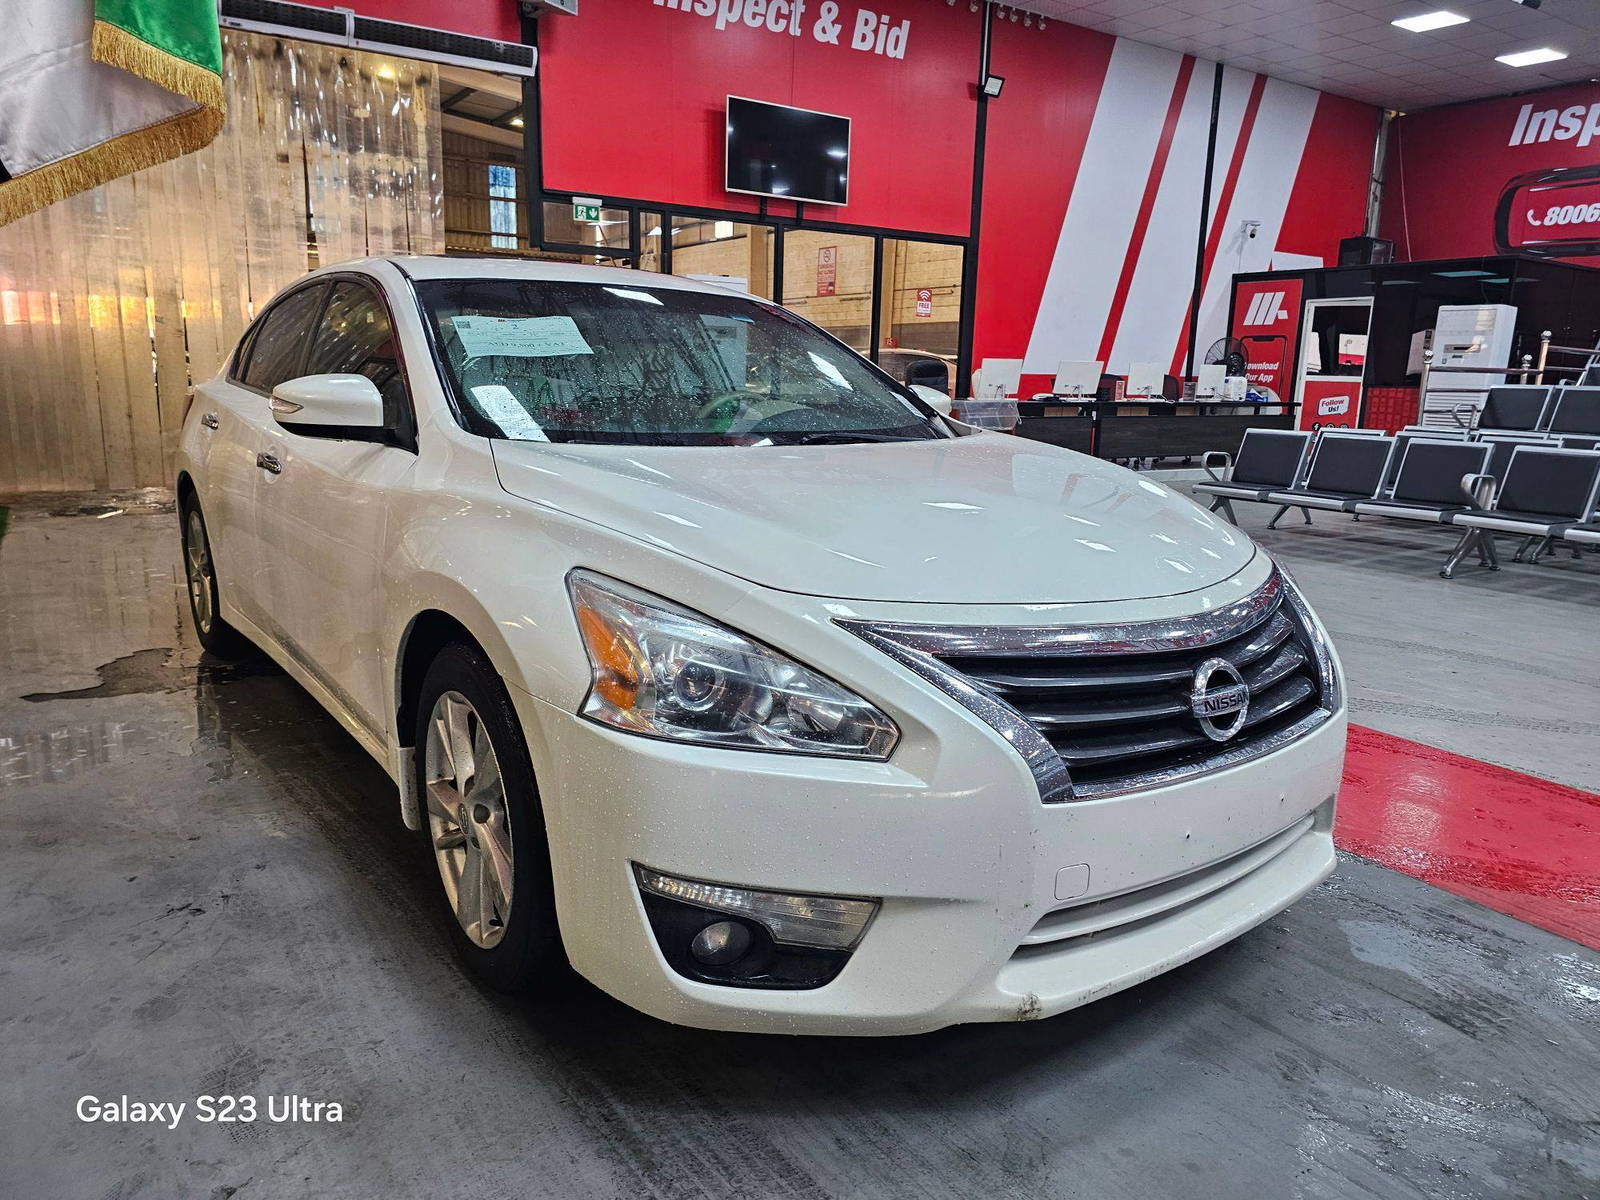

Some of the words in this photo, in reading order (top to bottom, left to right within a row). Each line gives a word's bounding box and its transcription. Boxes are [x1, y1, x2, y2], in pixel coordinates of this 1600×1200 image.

[653, 0, 805, 37] spect
[813, 0, 842, 46] &
[851, 8, 912, 60] Bid
[1543, 202, 1600, 227] 8006
[1244, 361, 1280, 371] ownload
[1245, 373, 1259, 381] Our
[1258, 373, 1274, 384] App
[1321, 399, 1345, 407] Follow
[1327, 405, 1340, 413] Us!
